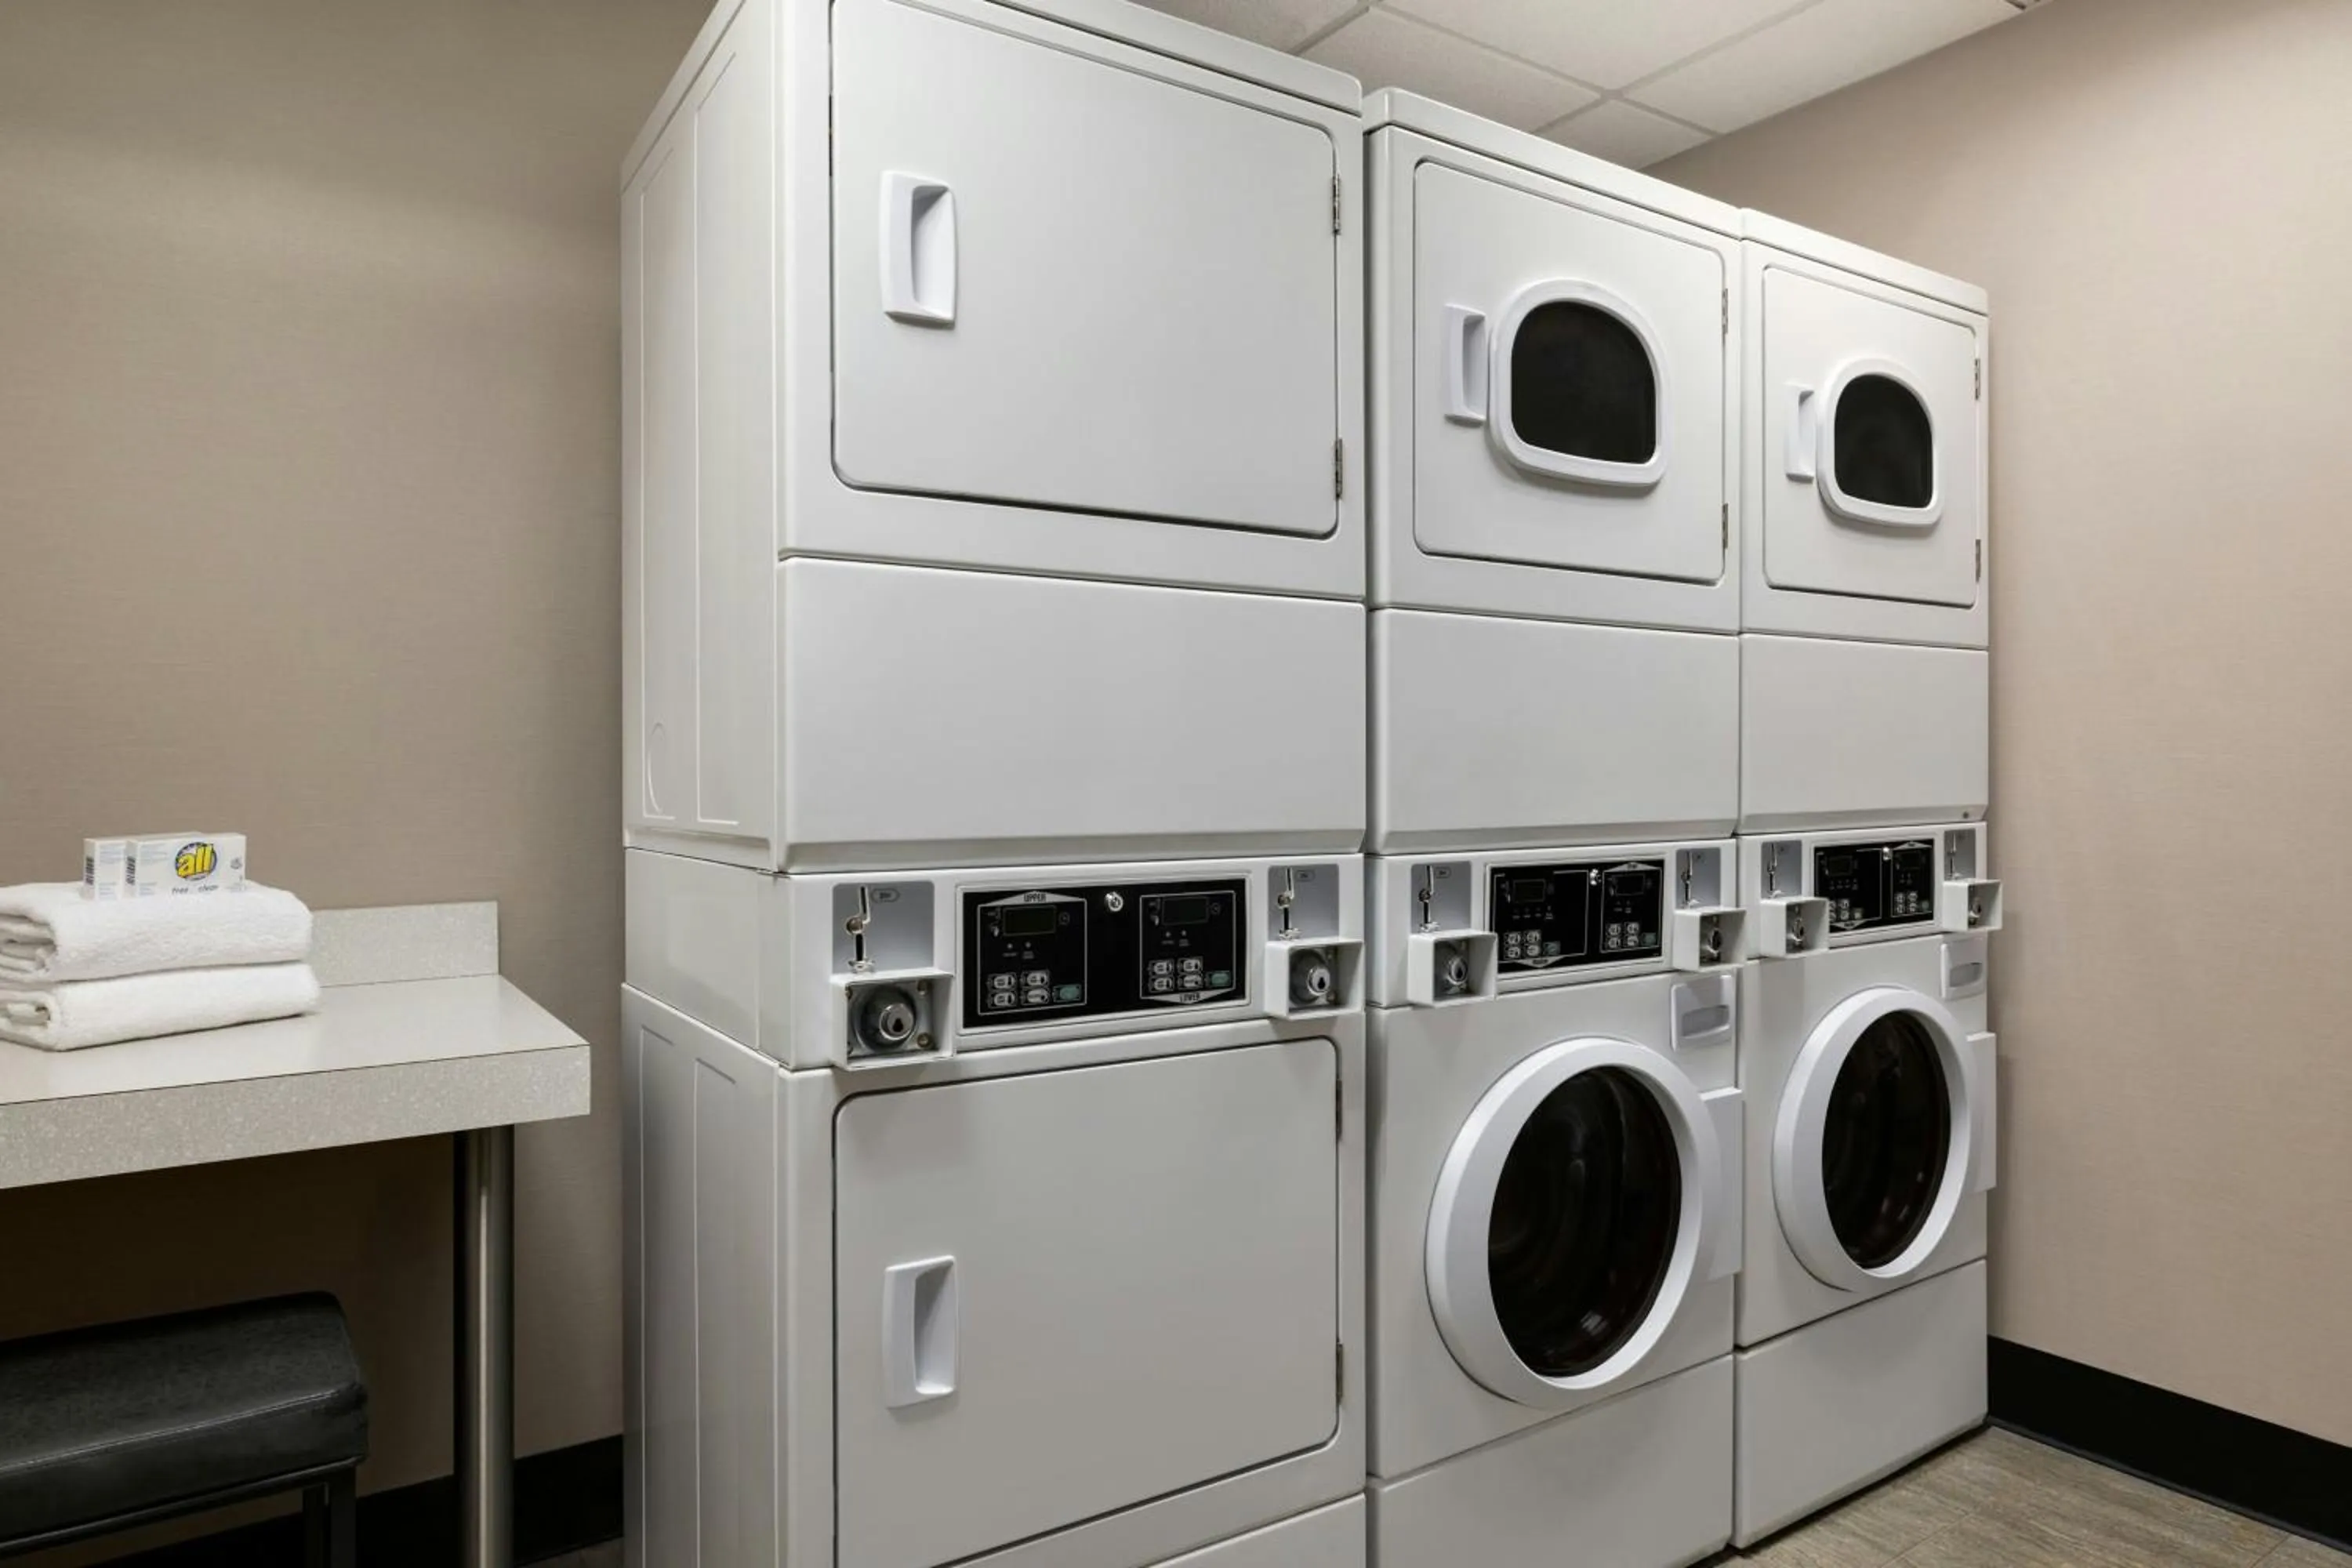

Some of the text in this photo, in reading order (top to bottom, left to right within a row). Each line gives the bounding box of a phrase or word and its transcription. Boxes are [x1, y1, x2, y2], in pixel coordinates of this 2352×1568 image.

[176, 844, 213, 877] all
[1023, 893, 1047, 902] UPPER
[1179, 993, 1200, 1002] LOWER
